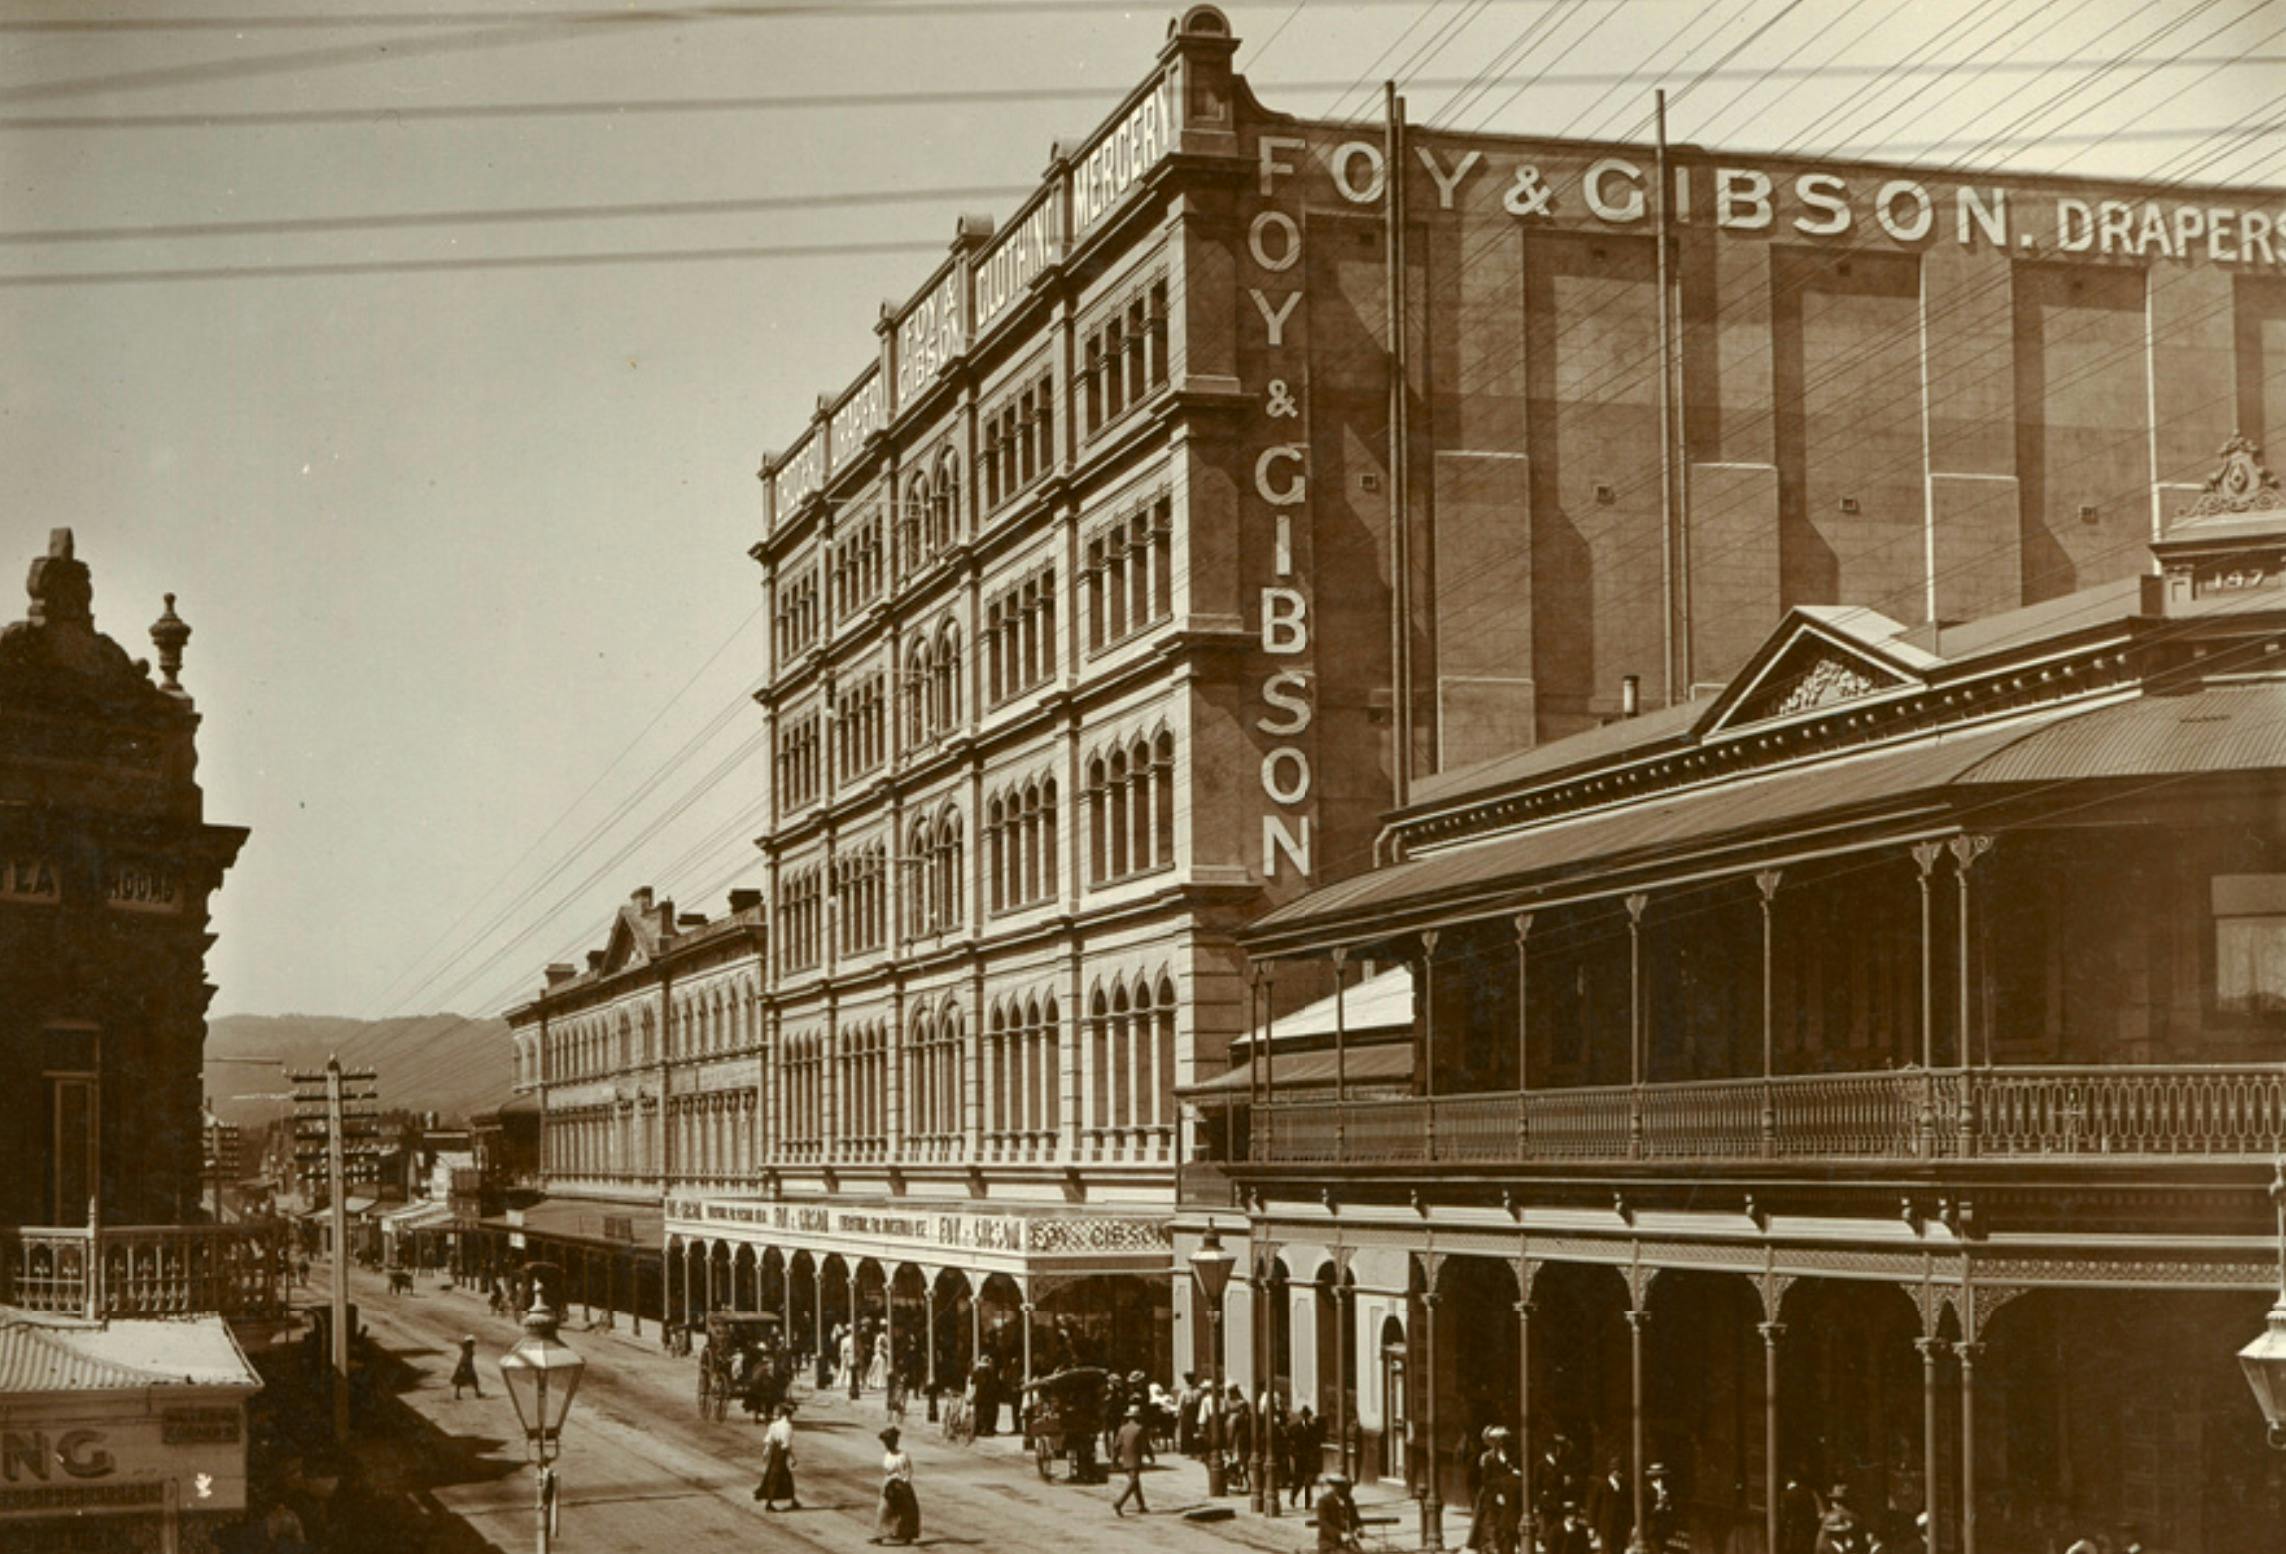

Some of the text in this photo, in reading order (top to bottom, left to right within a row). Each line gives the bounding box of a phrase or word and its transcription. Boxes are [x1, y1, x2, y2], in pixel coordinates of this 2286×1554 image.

[1503, 164, 1553, 218] &
[1249, 136, 1312, 878] FOY & GIBSON
